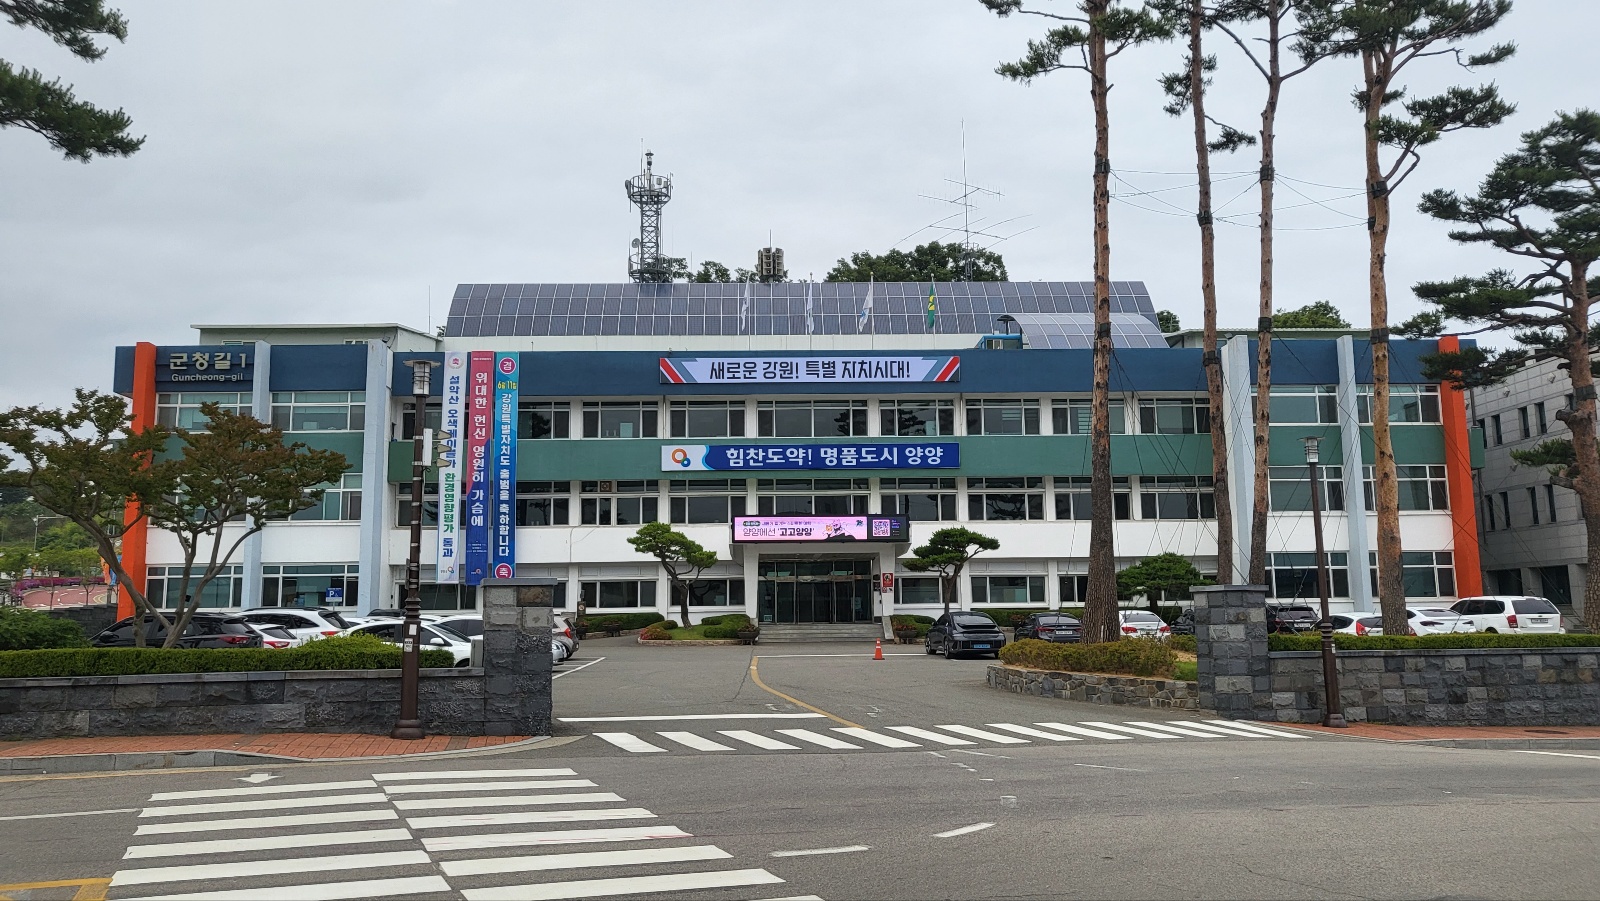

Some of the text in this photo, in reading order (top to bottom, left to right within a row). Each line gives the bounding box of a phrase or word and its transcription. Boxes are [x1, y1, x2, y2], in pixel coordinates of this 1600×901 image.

[170, 352, 246, 370] 군청길 1
[503, 361, 512, 371] 경
[709, 360, 911, 380] 새로운 강원! 특별 자치시대!
[171, 373, 243, 381] Guncheong-gil
[449, 375, 460, 404] 설악산
[475, 372, 487, 409] 위대한
[473, 415, 486, 440] 헌신
[472, 446, 485, 483] 영원히
[726, 446, 944, 466] 힘찬도약! 명품도시 양양
[498, 393, 512, 556] 강원특별자치도 출범을 축하합니다
[443, 473, 456, 533] 환경영향평가
[470, 490, 485, 527] 가슴에
[743, 527, 776, 536] 양양에선
[442, 538, 454, 557] 통과
[499, 567, 509, 577] 축
